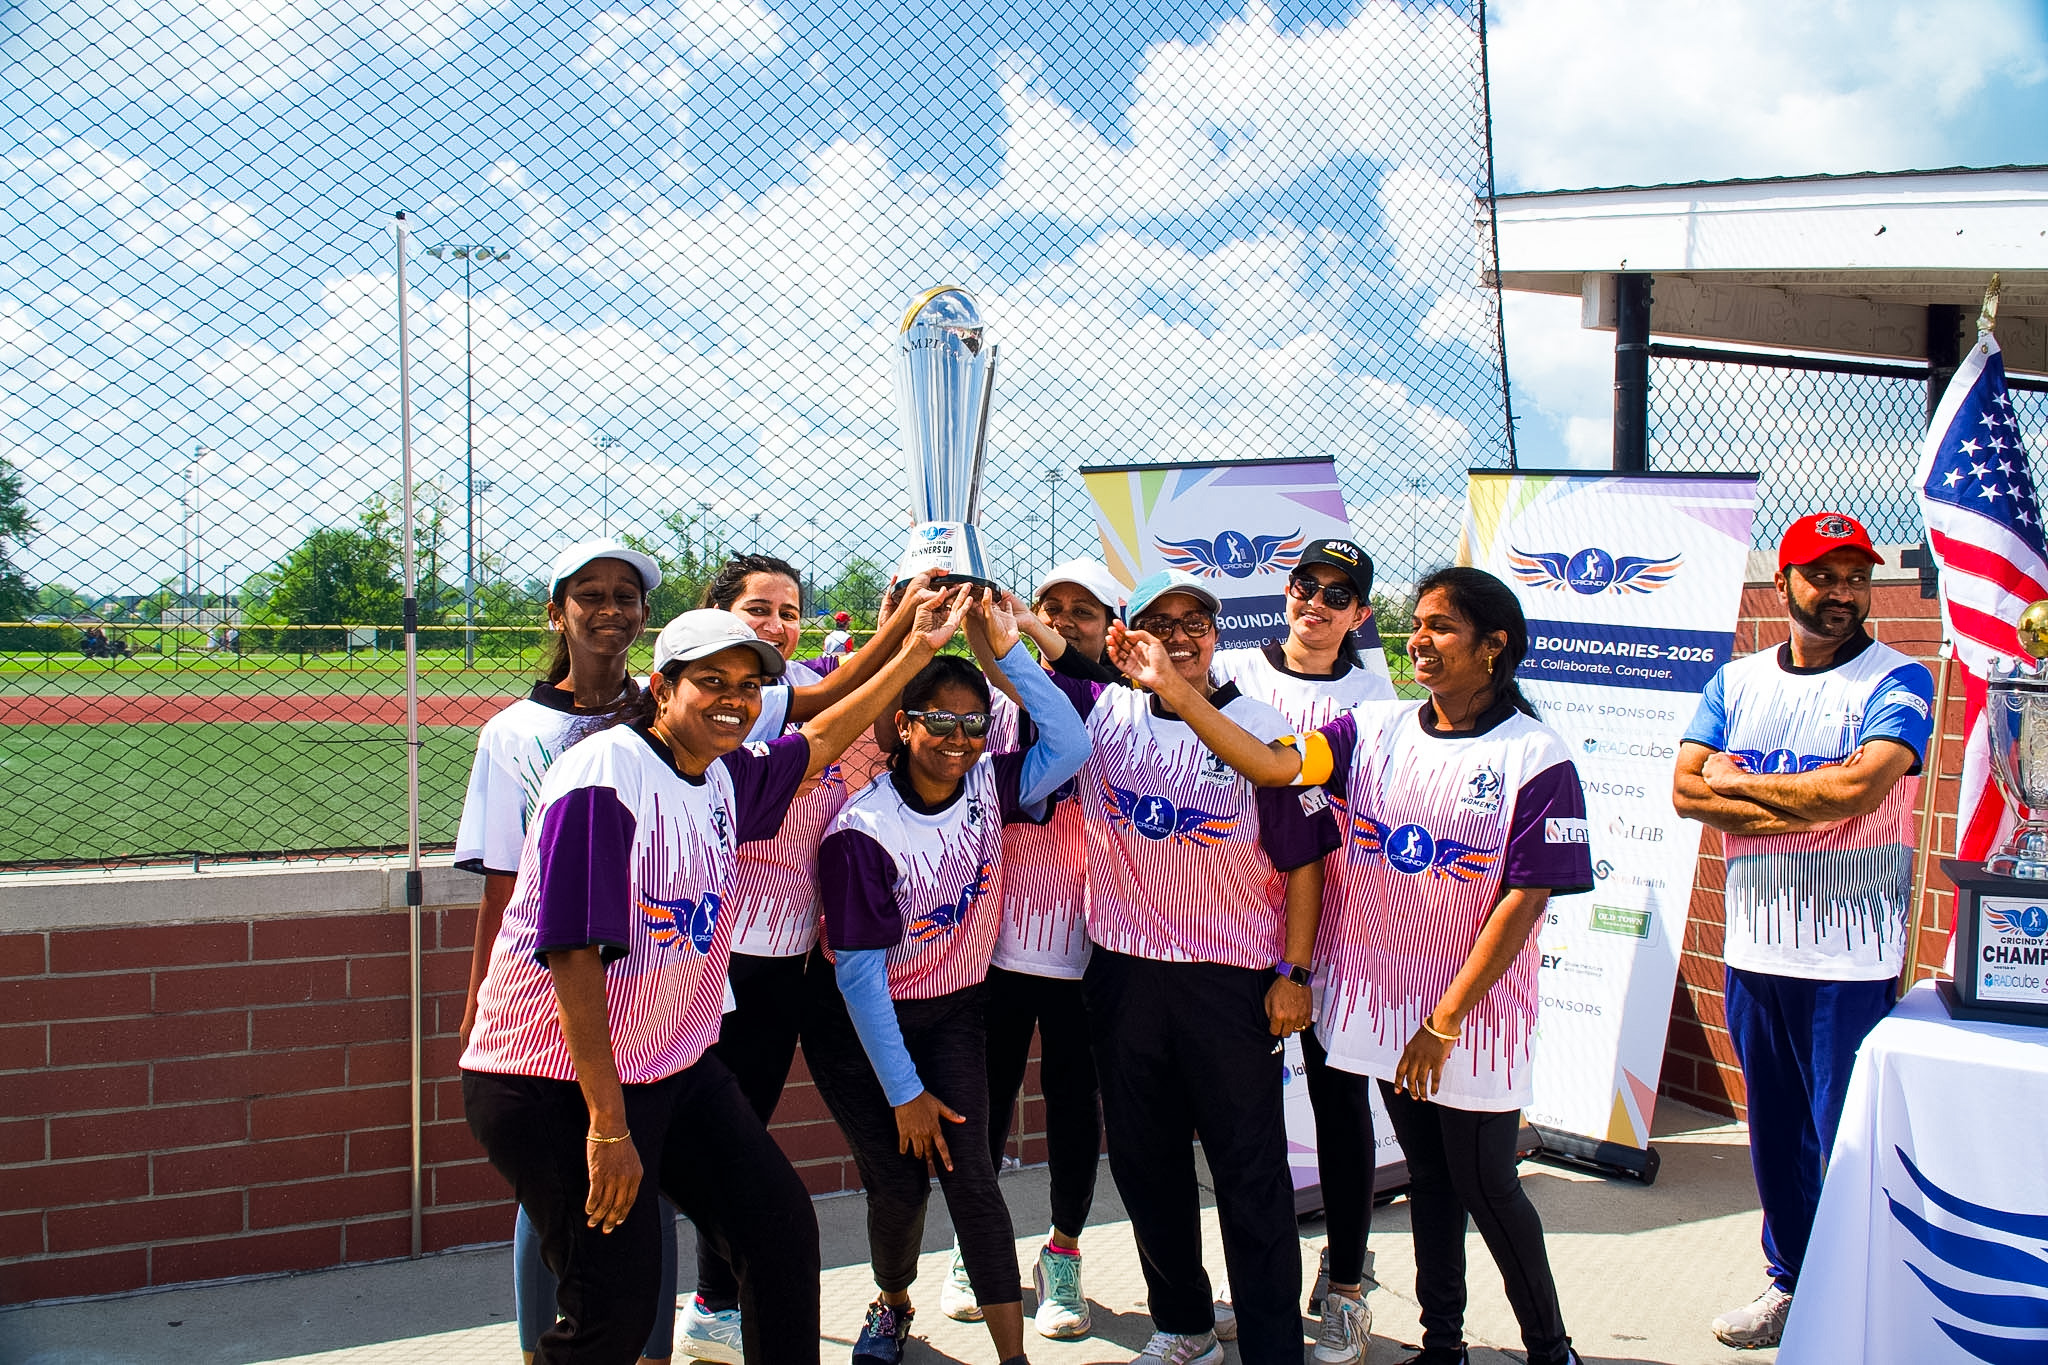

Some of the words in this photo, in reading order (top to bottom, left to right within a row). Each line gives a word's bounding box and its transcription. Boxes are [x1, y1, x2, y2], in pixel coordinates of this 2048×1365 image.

[942, 545, 953, 554] UP
[1325, 541, 1359, 560] aws
[1571, 579, 1608, 587] CRICINDY
[1224, 639, 1261, 649] Bridging
[1541, 658, 1613, 674] Collaborate.
[1615, 664, 1673, 680] Conquer.
[1566, 702, 1595, 713] DAY
[1598, 705, 1675, 721] SPONSORS
[1598, 740, 1674, 759] RADcube
[1200, 769, 1235, 782] WOMEN'S
[1460, 796, 1498, 811] WOMEN'S
[1597, 912, 1616, 921] OLD
[1617, 915, 1643, 925] TOWN
[2000, 936, 2044, 946] CRICINDY
[1993, 972, 2039, 988] RADcube
